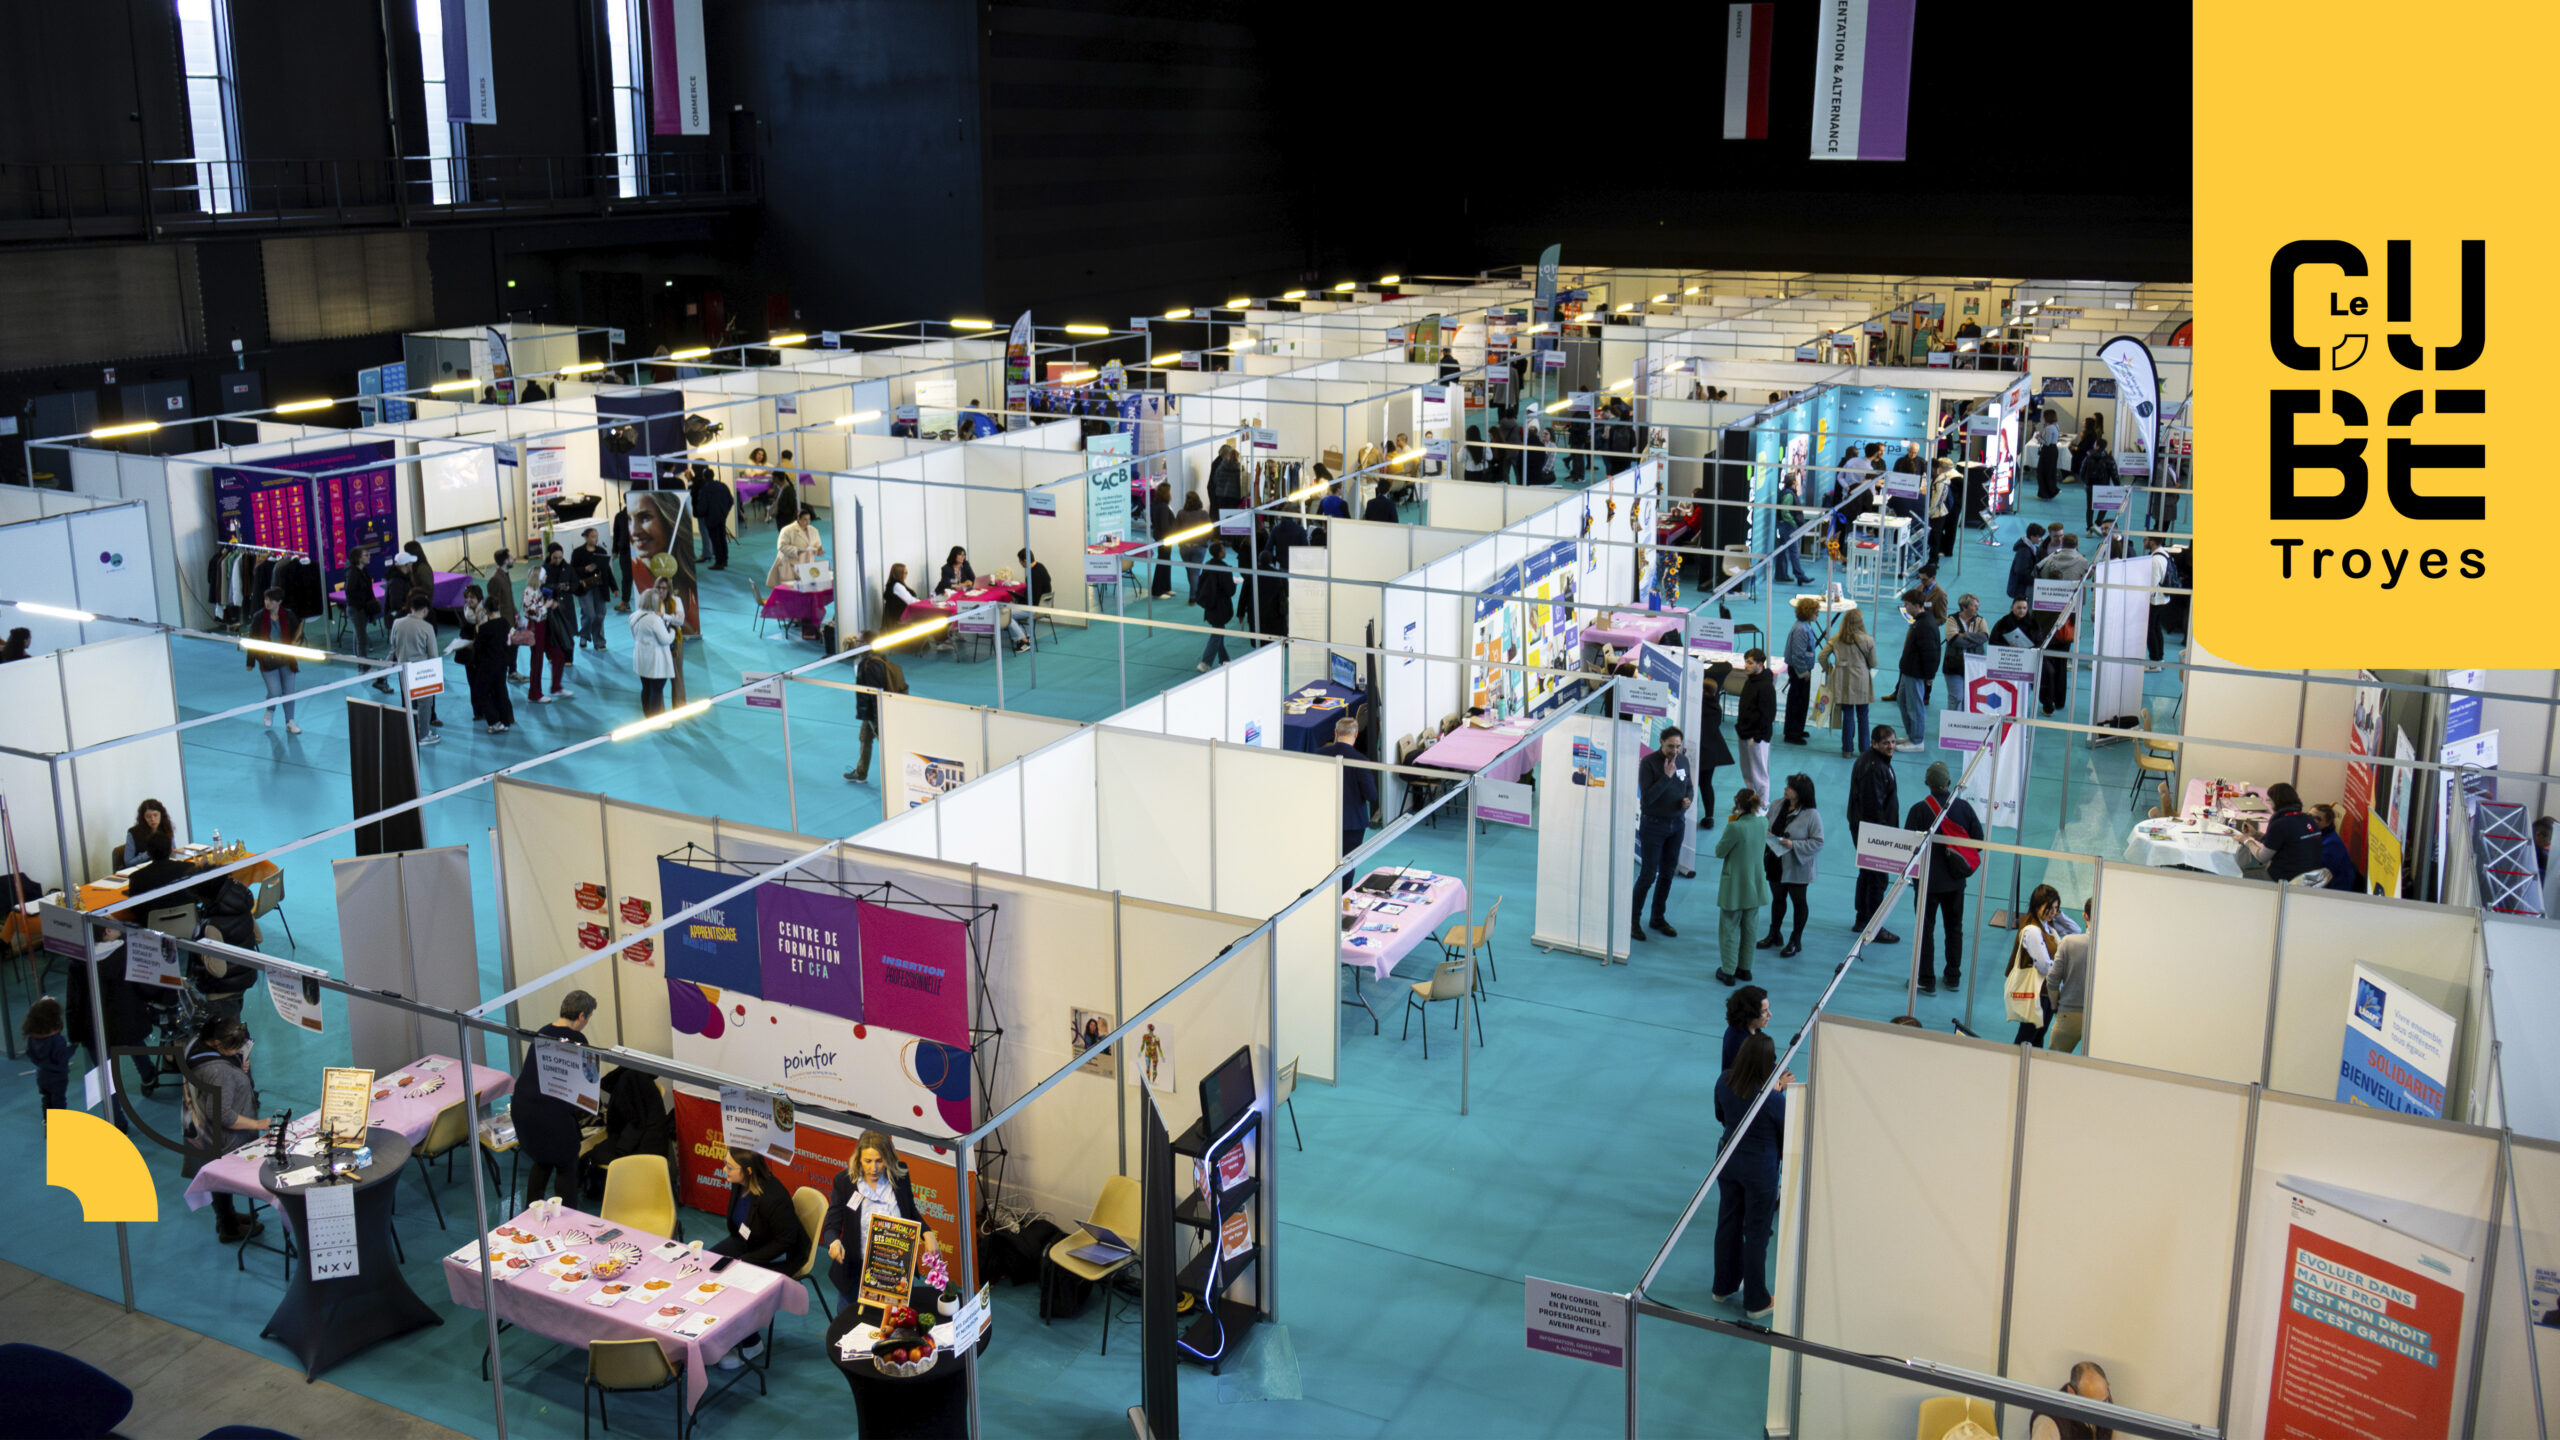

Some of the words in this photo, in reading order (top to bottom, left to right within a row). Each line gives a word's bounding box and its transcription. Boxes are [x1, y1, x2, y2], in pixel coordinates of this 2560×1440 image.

[1834, 64, 1844, 74] &
[480, 77, 489, 118] ATELIERS
[689, 75, 700, 127] COMMERCE
[1828, 76, 1843, 153] ALTERNANCE
[1092, 468, 1129, 492] CACB
[1868, 838, 1893, 847] LADAPT
[1894, 842, 1912, 851] AUBE
[690, 925, 738, 942] APPRENTISSAGE
[779, 921, 819, 943] CENTRE
[825, 932, 838, 947] DE
[778, 938, 840, 965] FORMATION
[792, 958, 803, 973] ET
[808, 962, 829, 979] CFA
[882, 955, 946, 977] INSERTION
[885, 967, 942, 996] PROFESSIONNELLE
[2393, 1022, 2407, 1036] tous
[2394, 1009, 2410, 1026] Vivre
[2411, 1020, 2444, 1048] ensemble,
[2391, 1032, 2405, 1046] tous
[542, 1054, 552, 1062] BTS
[554, 1057, 579, 1069] OPTICIEN
[543, 1064, 568, 1076] LUNETIER
[784, 1043, 837, 1078] poinfor
[2368, 1049, 2442, 1111] SOLIDARITÉ
[735, 1116, 768, 1129] NUTRITION
[738, 1107, 772, 1120] DIÉTÉTIQUE
[694, 1143, 728, 1160] GRAN
[697, 1175, 732, 1190] HAUTE-M
[874, 1234, 884, 1242] BTS
[2297, 1267, 2318, 1286] MA
[2322, 1277, 2347, 1296] VIE
[2351, 1289, 2382, 1310] PRO
[2298, 1251, 2364, 1287] ÉVOLUER
[2368, 1280, 2412, 1306] DANS
[1551, 1292, 1567, 1300] MON
[1569, 1295, 1599, 1307] CONSEIL
[1560, 1302, 1601, 1317] ÉVOLUTION
[1539, 1308, 1606, 1328] PROFESSIONNELLE
[2294, 1283, 2336, 1307] C'EST
[2337, 1300, 2374, 1324] MON
[2378, 1316, 2428, 1345] DROIT
[1549, 1320, 1574, 1330] AVENIR
[1576, 1326, 1600, 1336] ACTIFS
[2292, 1298, 2311, 1314] ET
[2312, 1308, 2355, 1331] C'EST
[2356, 1325, 2425, 1361] GRATUIT
[2428, 1353, 2434, 1365] !
